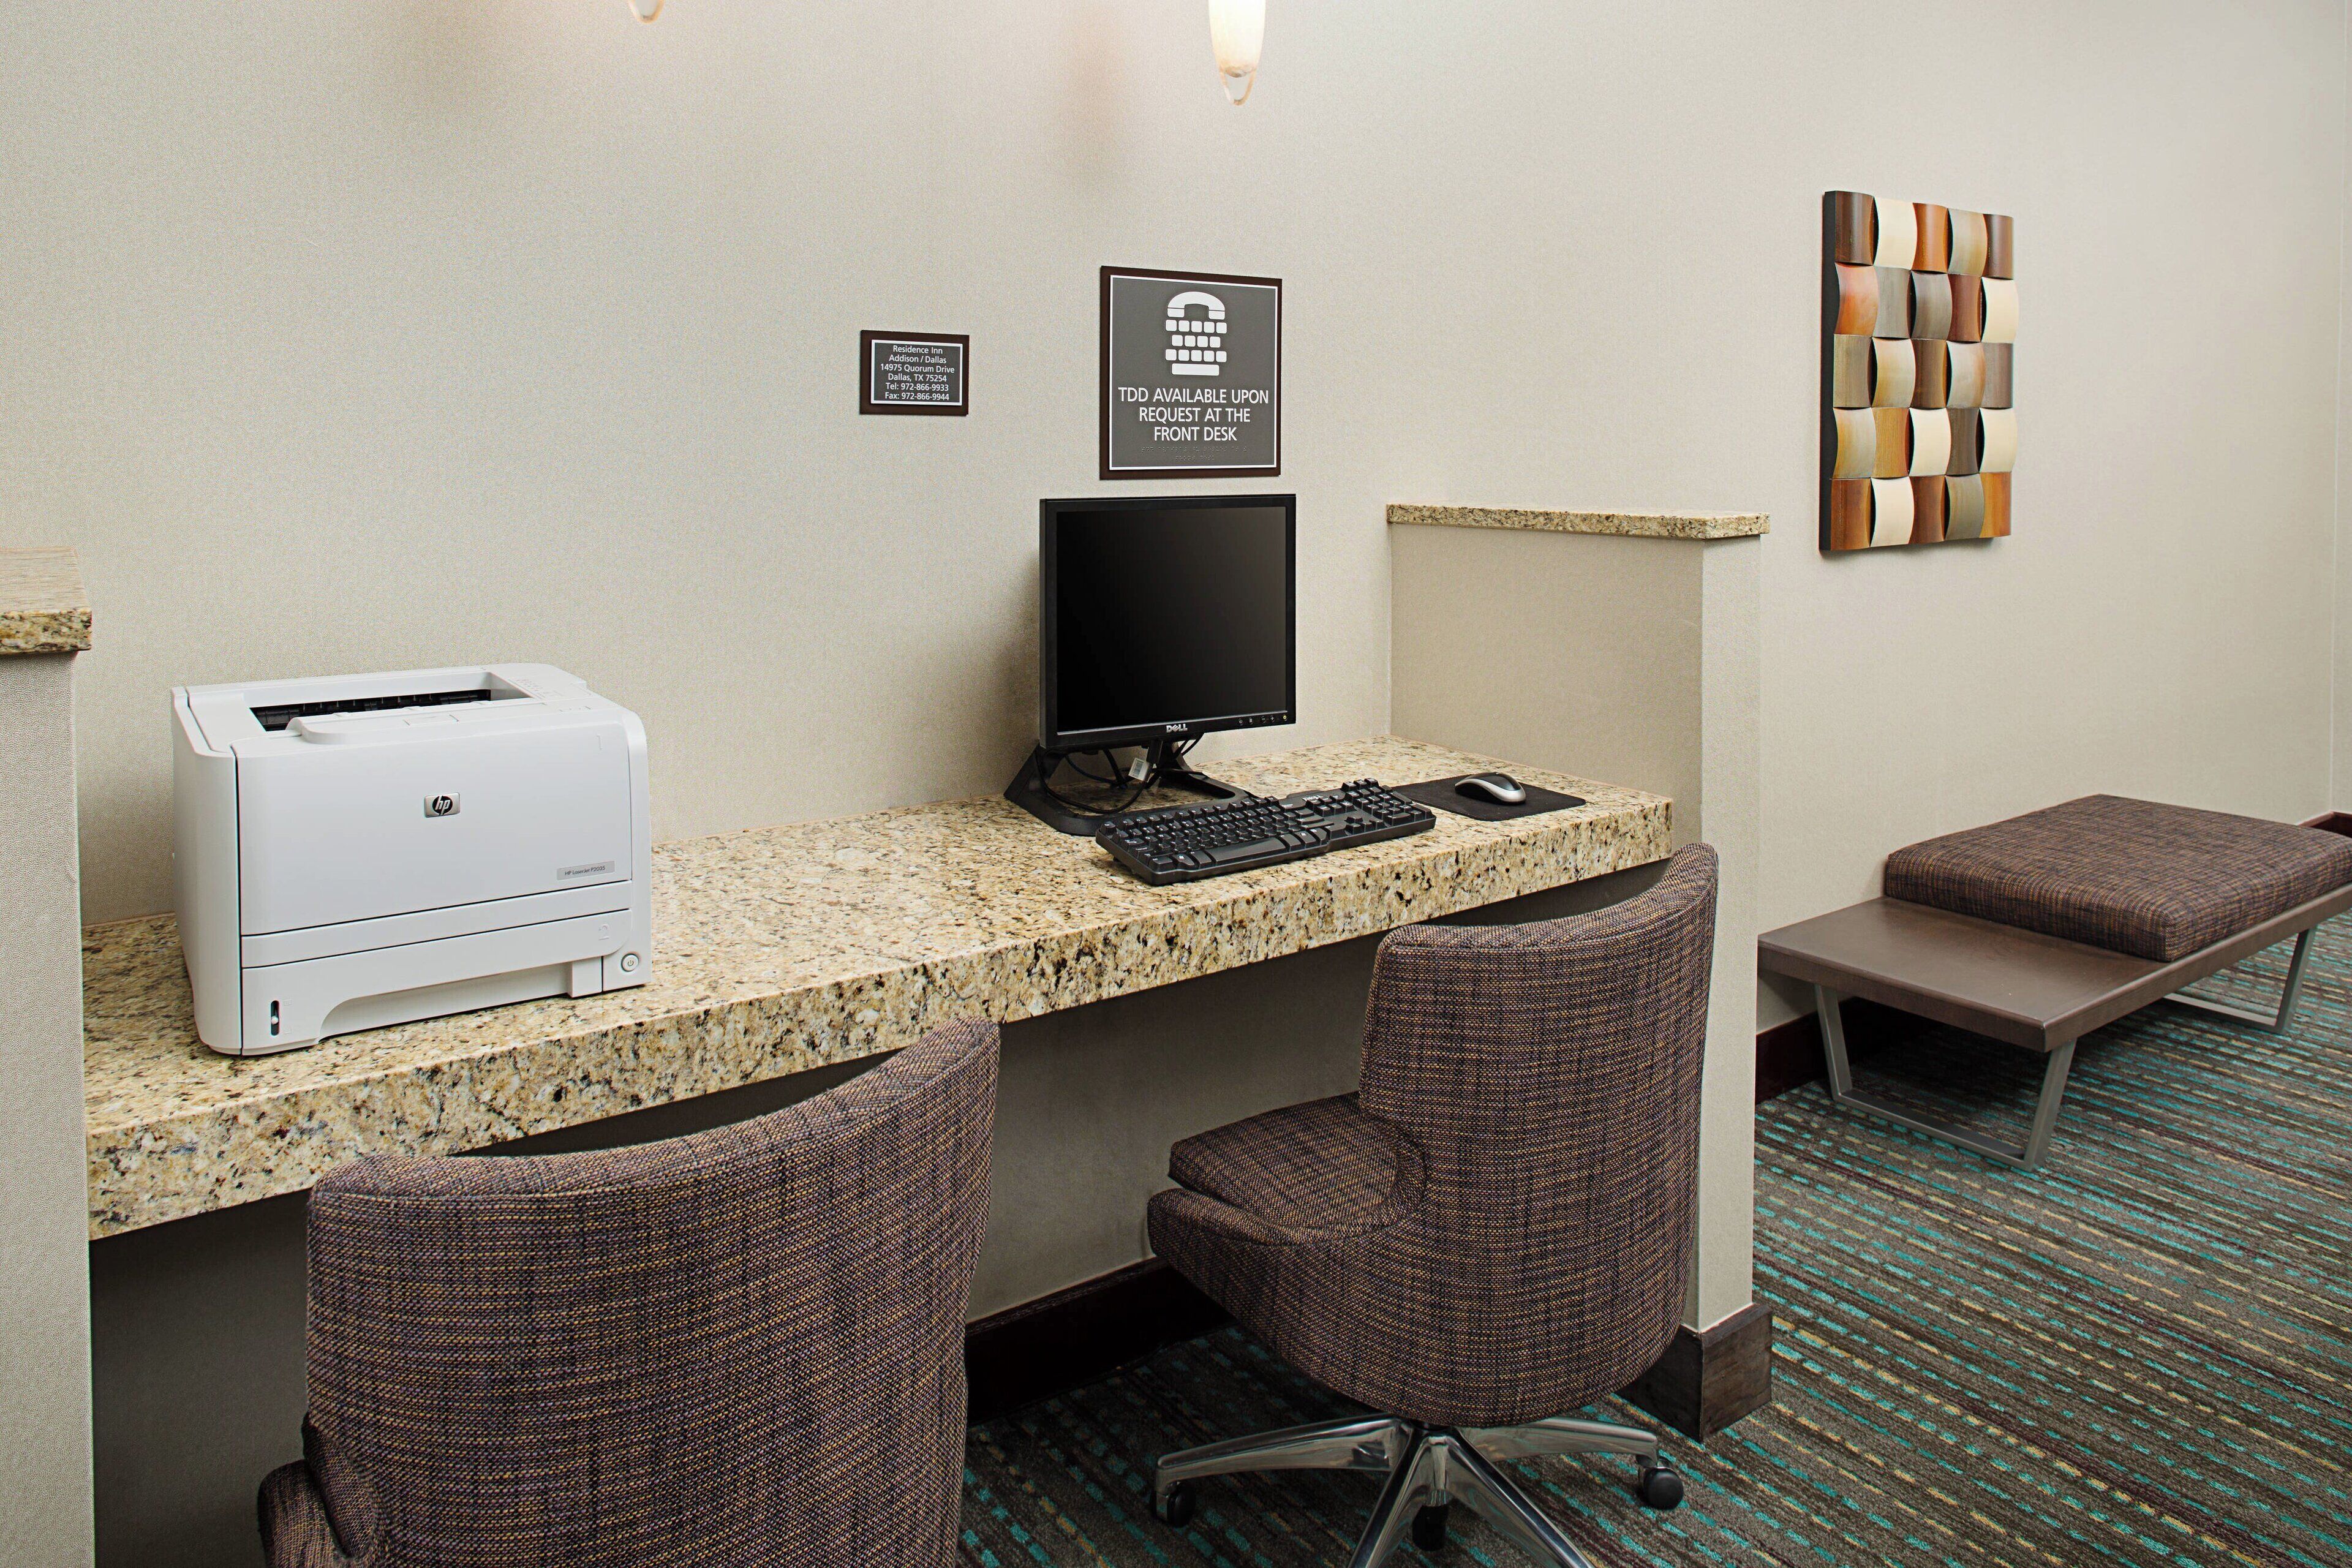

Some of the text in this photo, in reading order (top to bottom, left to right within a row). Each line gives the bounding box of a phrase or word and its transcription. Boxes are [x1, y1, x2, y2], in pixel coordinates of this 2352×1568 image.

[892, 345, 929, 354] Residence
[889, 354, 919, 363] Addison
[925, 355, 947, 364] Dallas
[903, 364, 934, 373] Quorum
[936, 365, 955, 374] Drive
[888, 373, 912, 382] Dallas,
[900, 383, 949, 391] 972-866-9933
[901, 392, 949, 401] 972-866-9944
[1118, 386, 1268, 404] TDD AVAILABLE UPON
[1139, 407, 1251, 424] REQUEST AT THE
[1154, 426, 1238, 442] FRONT DESK
[1166, 723, 1188, 733] DELL
[434, 795, 451, 815] hp
